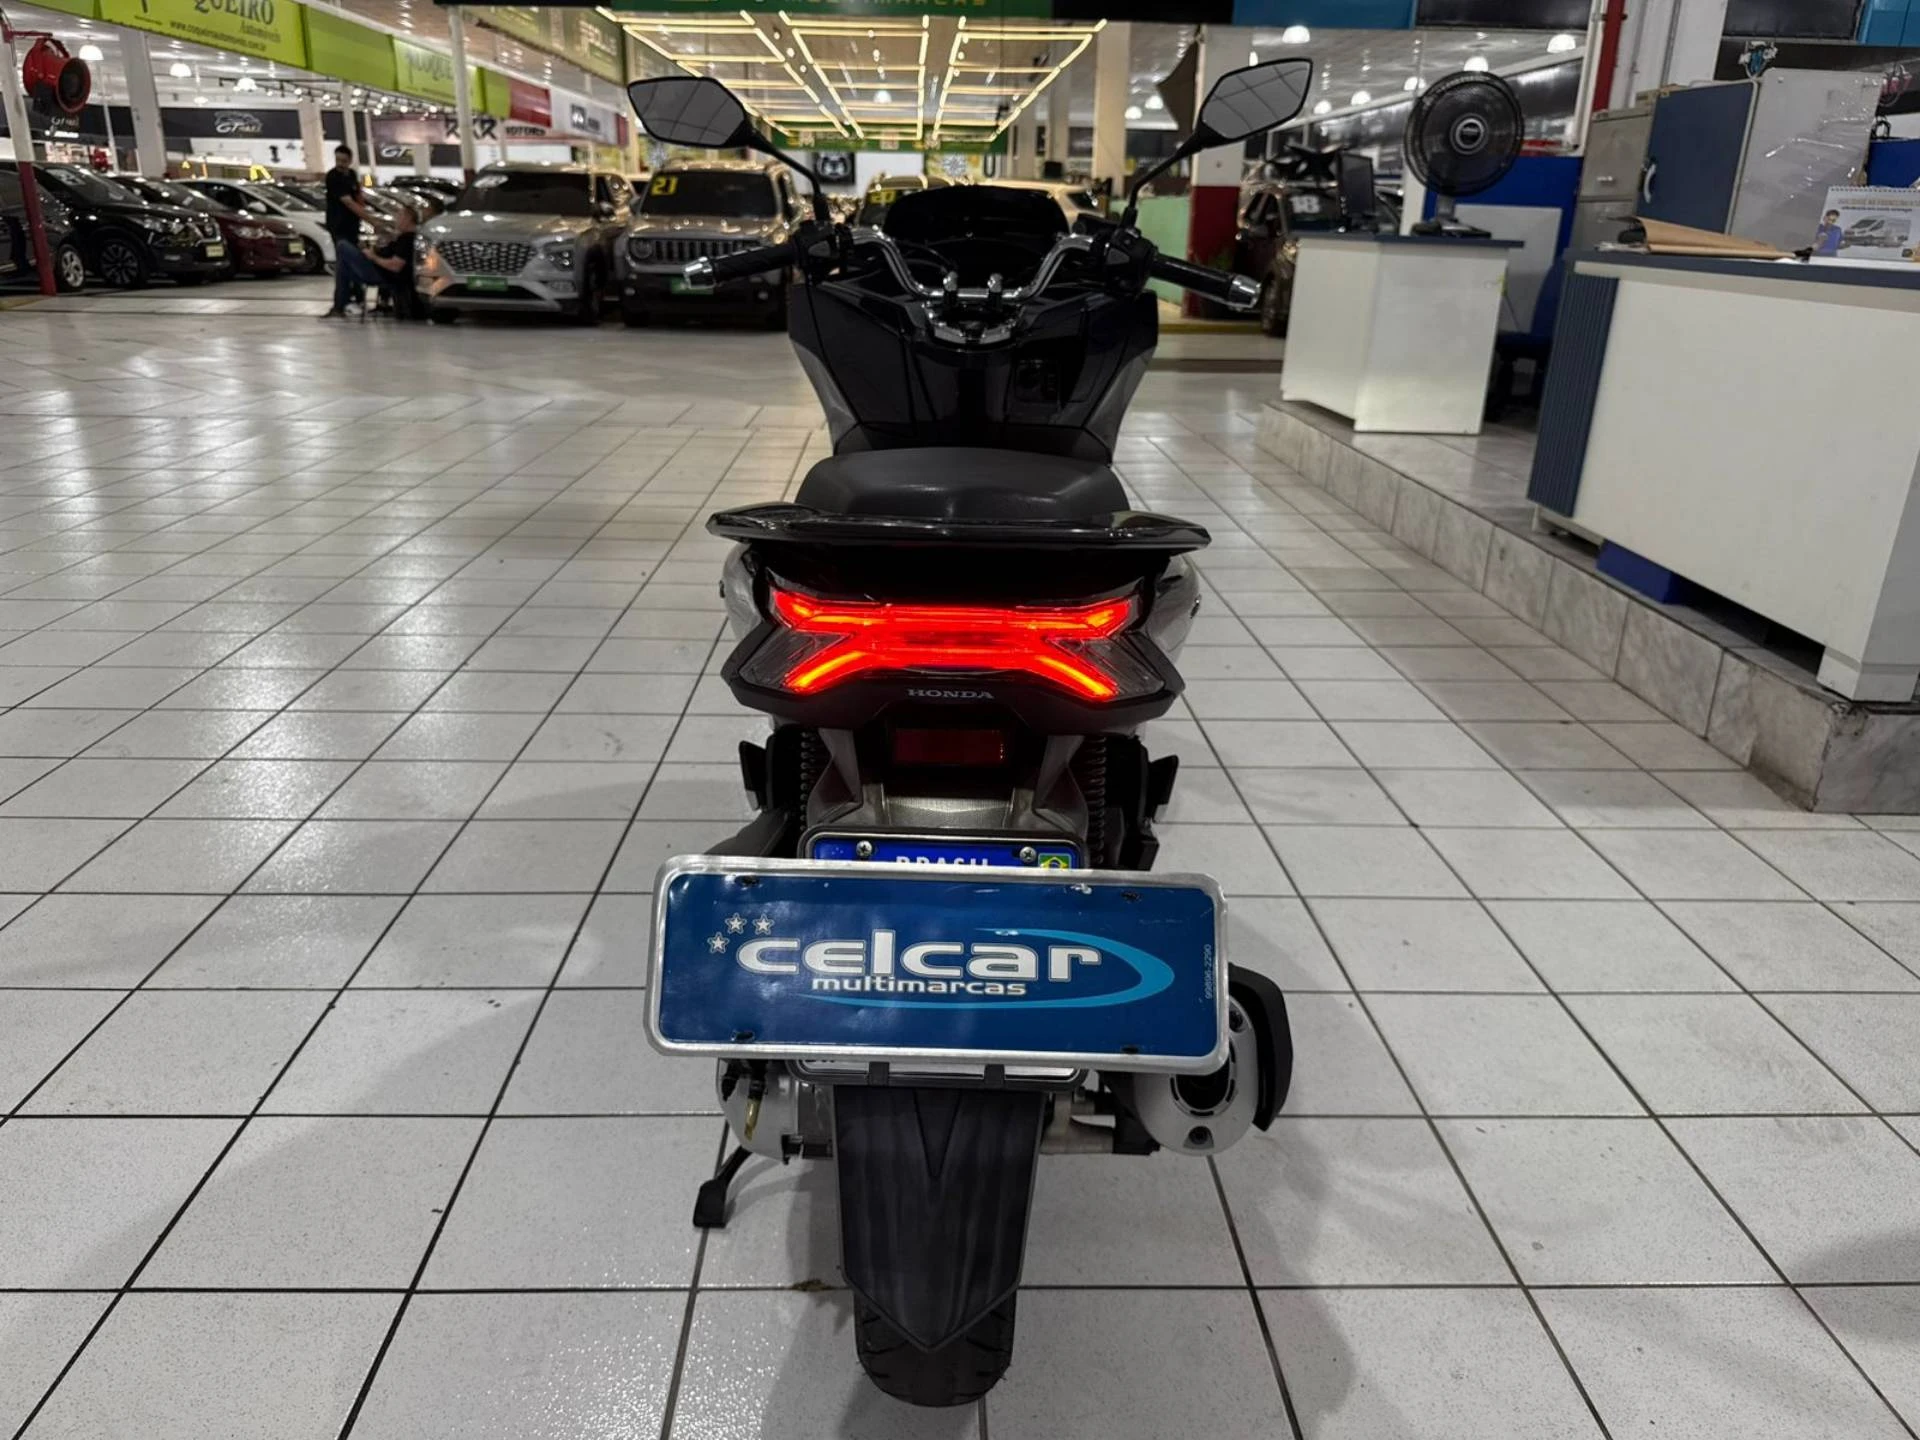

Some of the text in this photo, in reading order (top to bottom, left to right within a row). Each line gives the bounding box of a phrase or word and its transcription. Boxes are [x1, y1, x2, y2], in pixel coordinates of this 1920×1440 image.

[908, 688, 994, 699] HONDA
[736, 928, 1102, 983] celcar
[812, 976, 1028, 996] multimarcas
